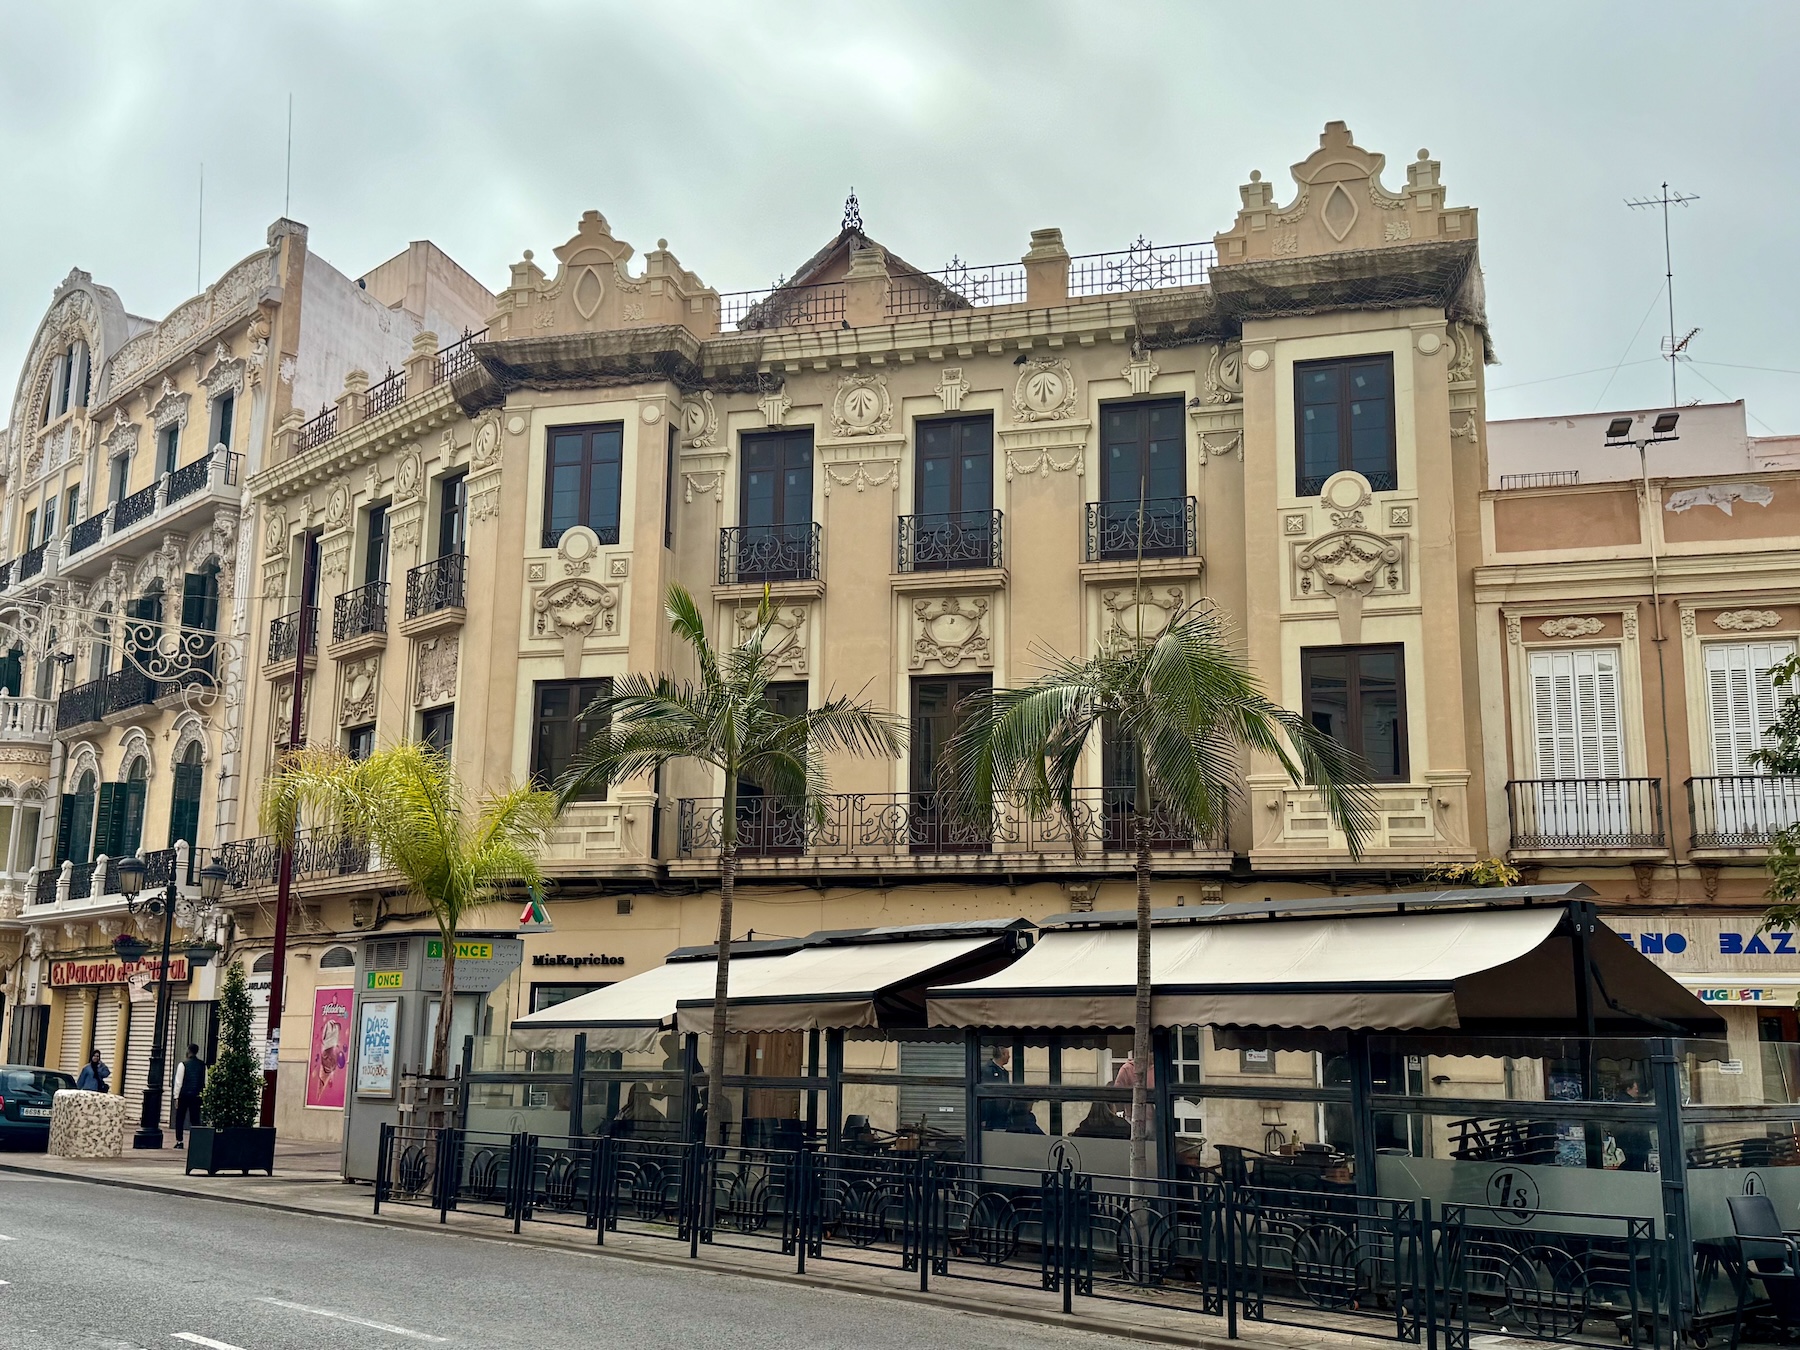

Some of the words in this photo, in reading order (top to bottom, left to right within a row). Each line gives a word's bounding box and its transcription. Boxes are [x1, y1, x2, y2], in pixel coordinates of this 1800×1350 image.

[1719, 933, 1800, 954] BAZ
[532, 953, 624, 968] MisKaprichos
[377, 974, 400, 986] ONCE
[366, 1016, 380, 1034] DÍA
[365, 1030, 390, 1056] PADRE
